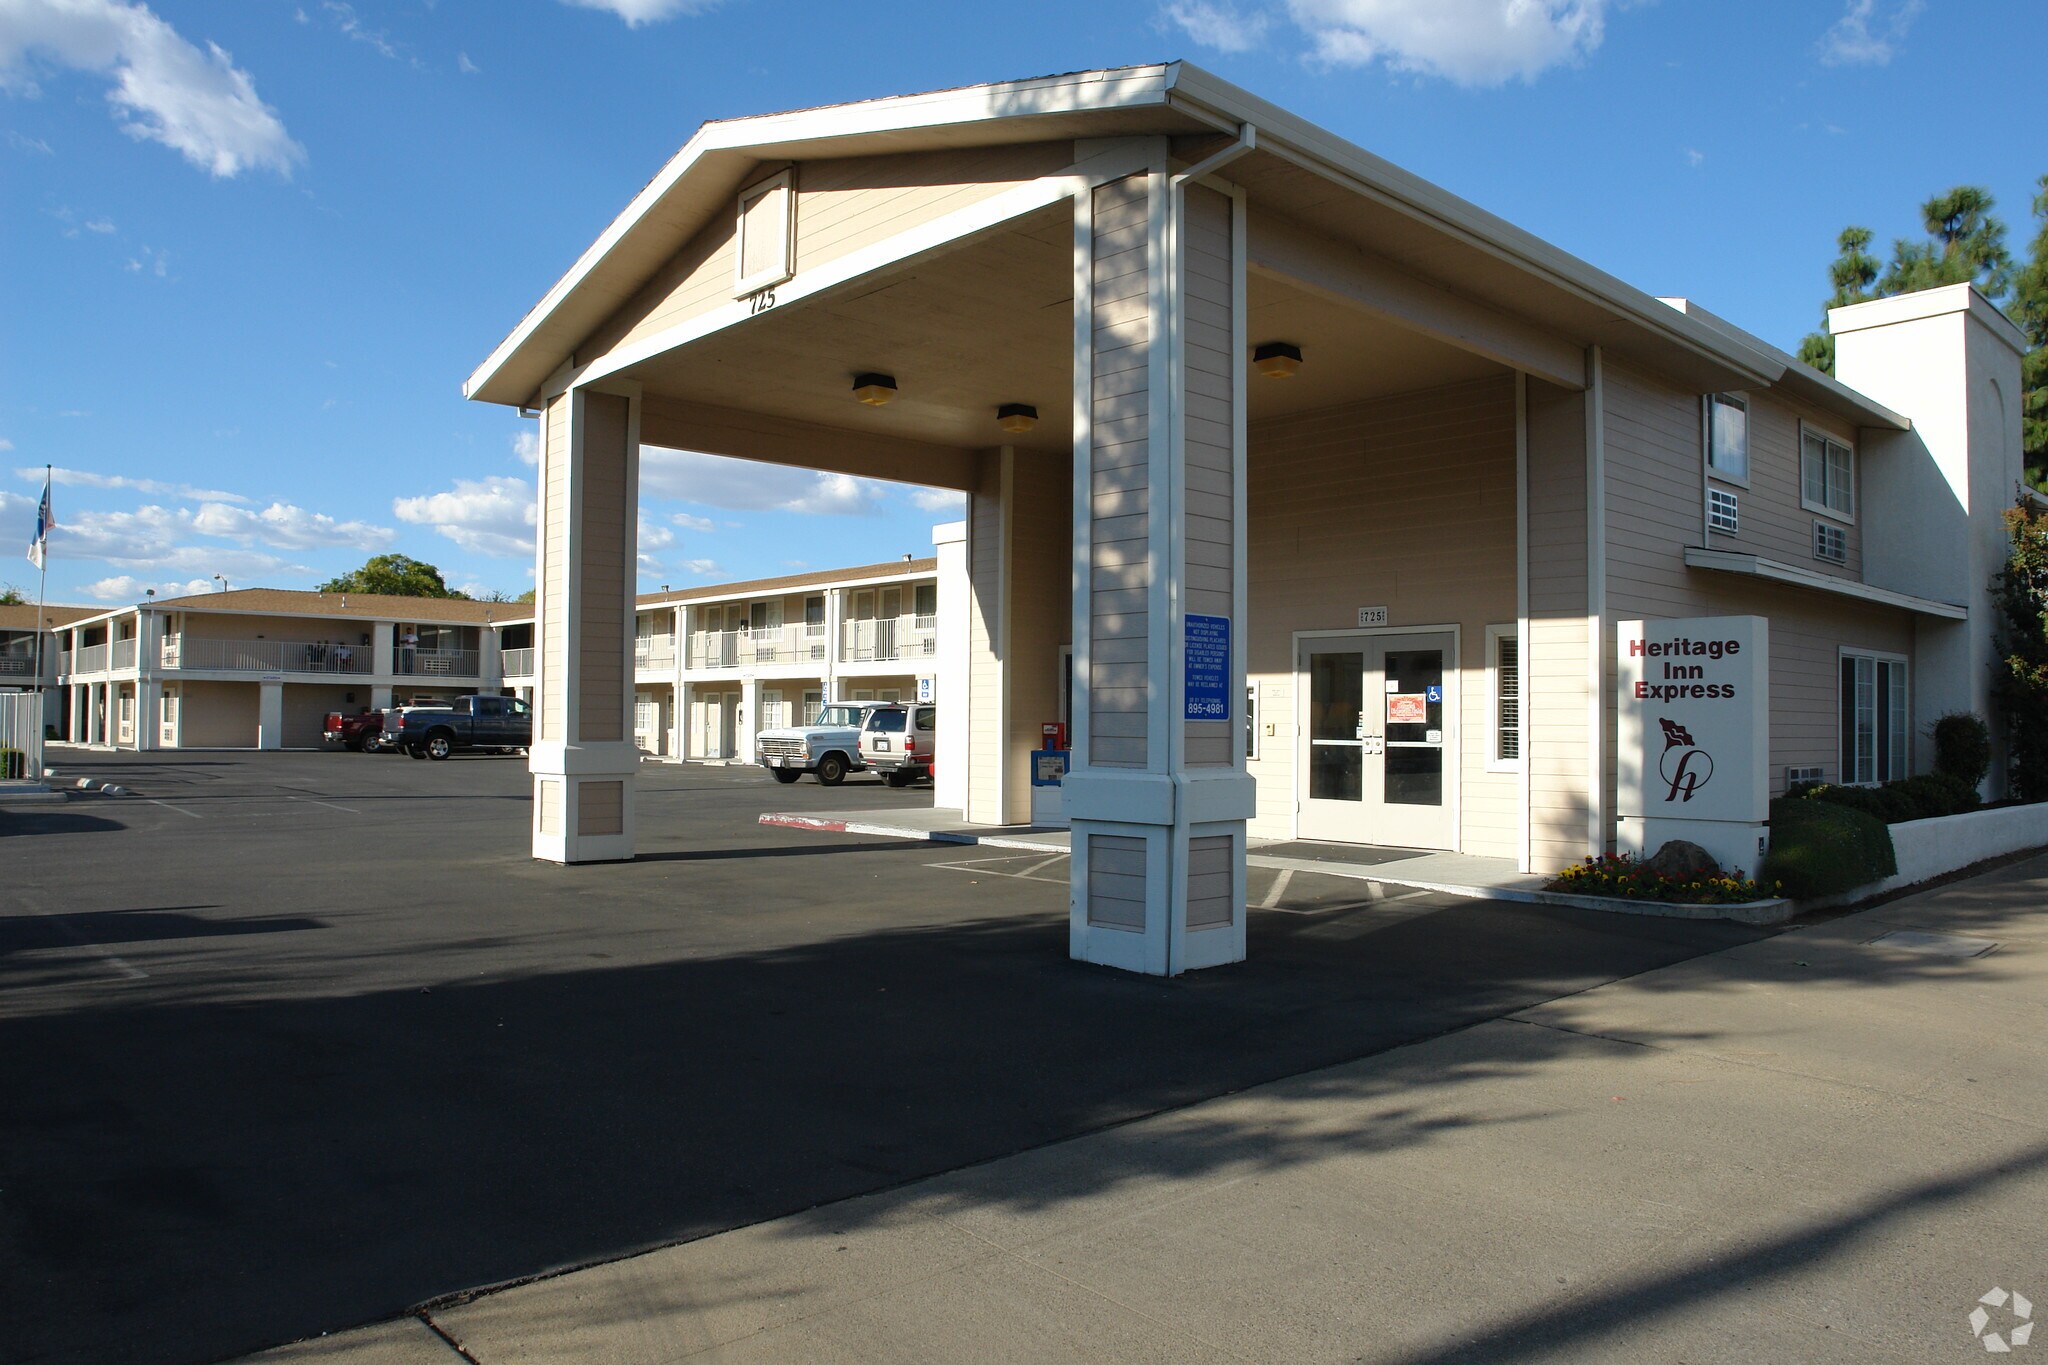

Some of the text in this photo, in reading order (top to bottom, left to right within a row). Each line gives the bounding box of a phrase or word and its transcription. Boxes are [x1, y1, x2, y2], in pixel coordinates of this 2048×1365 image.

[749, 287, 776, 315] 725
[1363, 611, 1382, 622] 725
[1630, 638, 1740, 660] Heritage
[1664, 662, 1704, 679] Inn
[1635, 681, 1735, 703] Express
[1188, 703, 1224, 714] 895-4981
